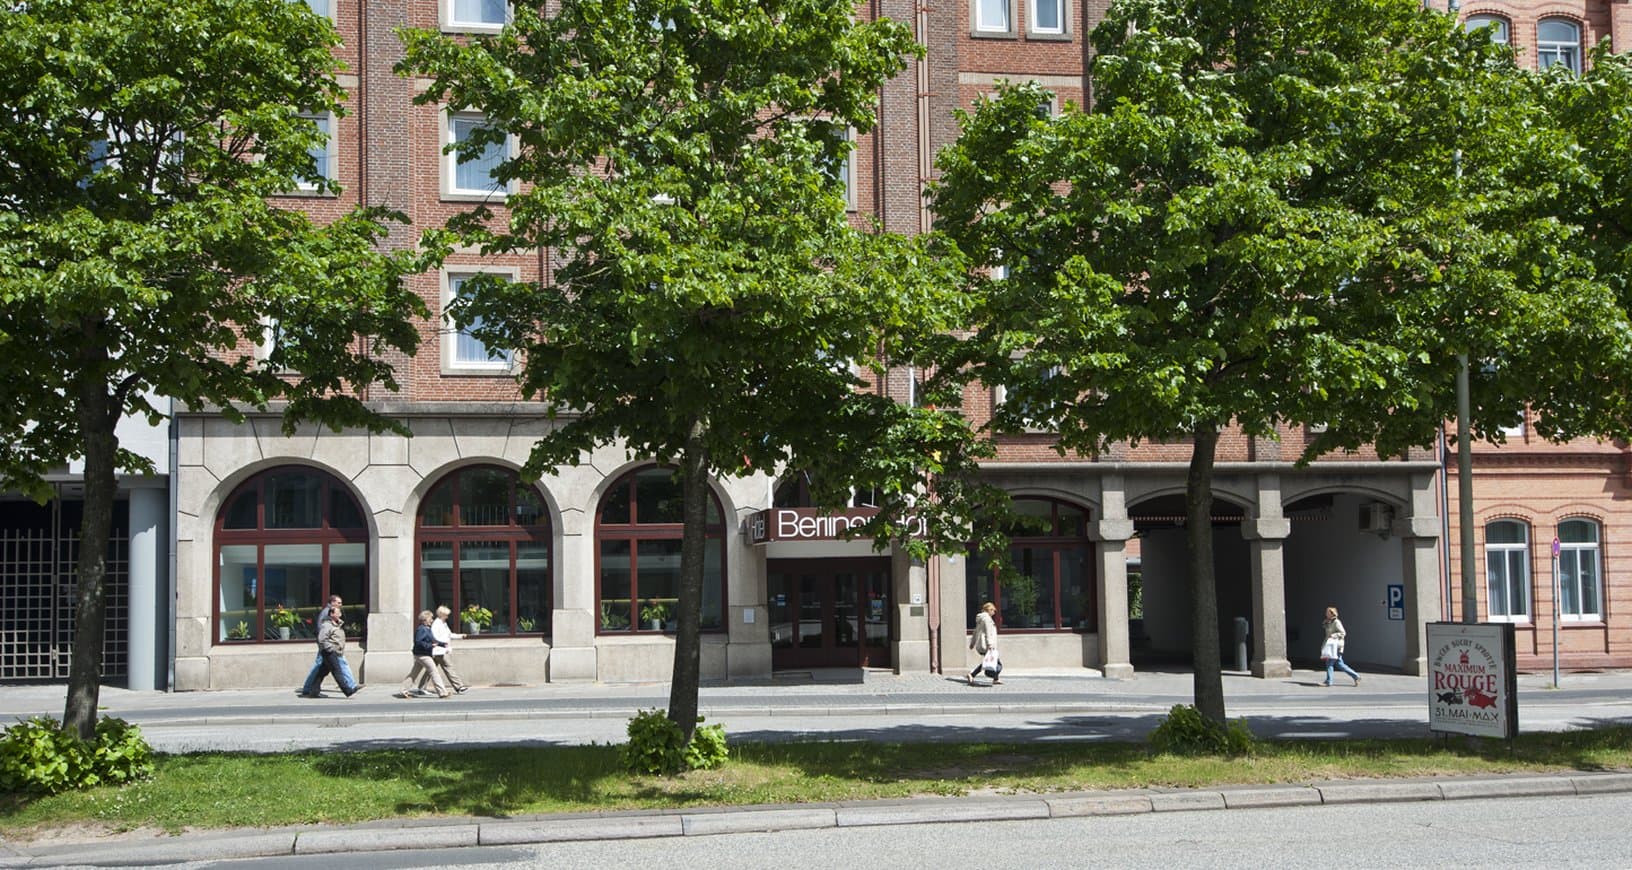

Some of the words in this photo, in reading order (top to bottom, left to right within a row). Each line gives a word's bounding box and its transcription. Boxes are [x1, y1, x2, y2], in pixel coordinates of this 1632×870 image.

[1390, 586, 1402, 607] P
[1444, 663, 1486, 674] MAXIMUM
[1434, 670, 1498, 693] ROUGE
